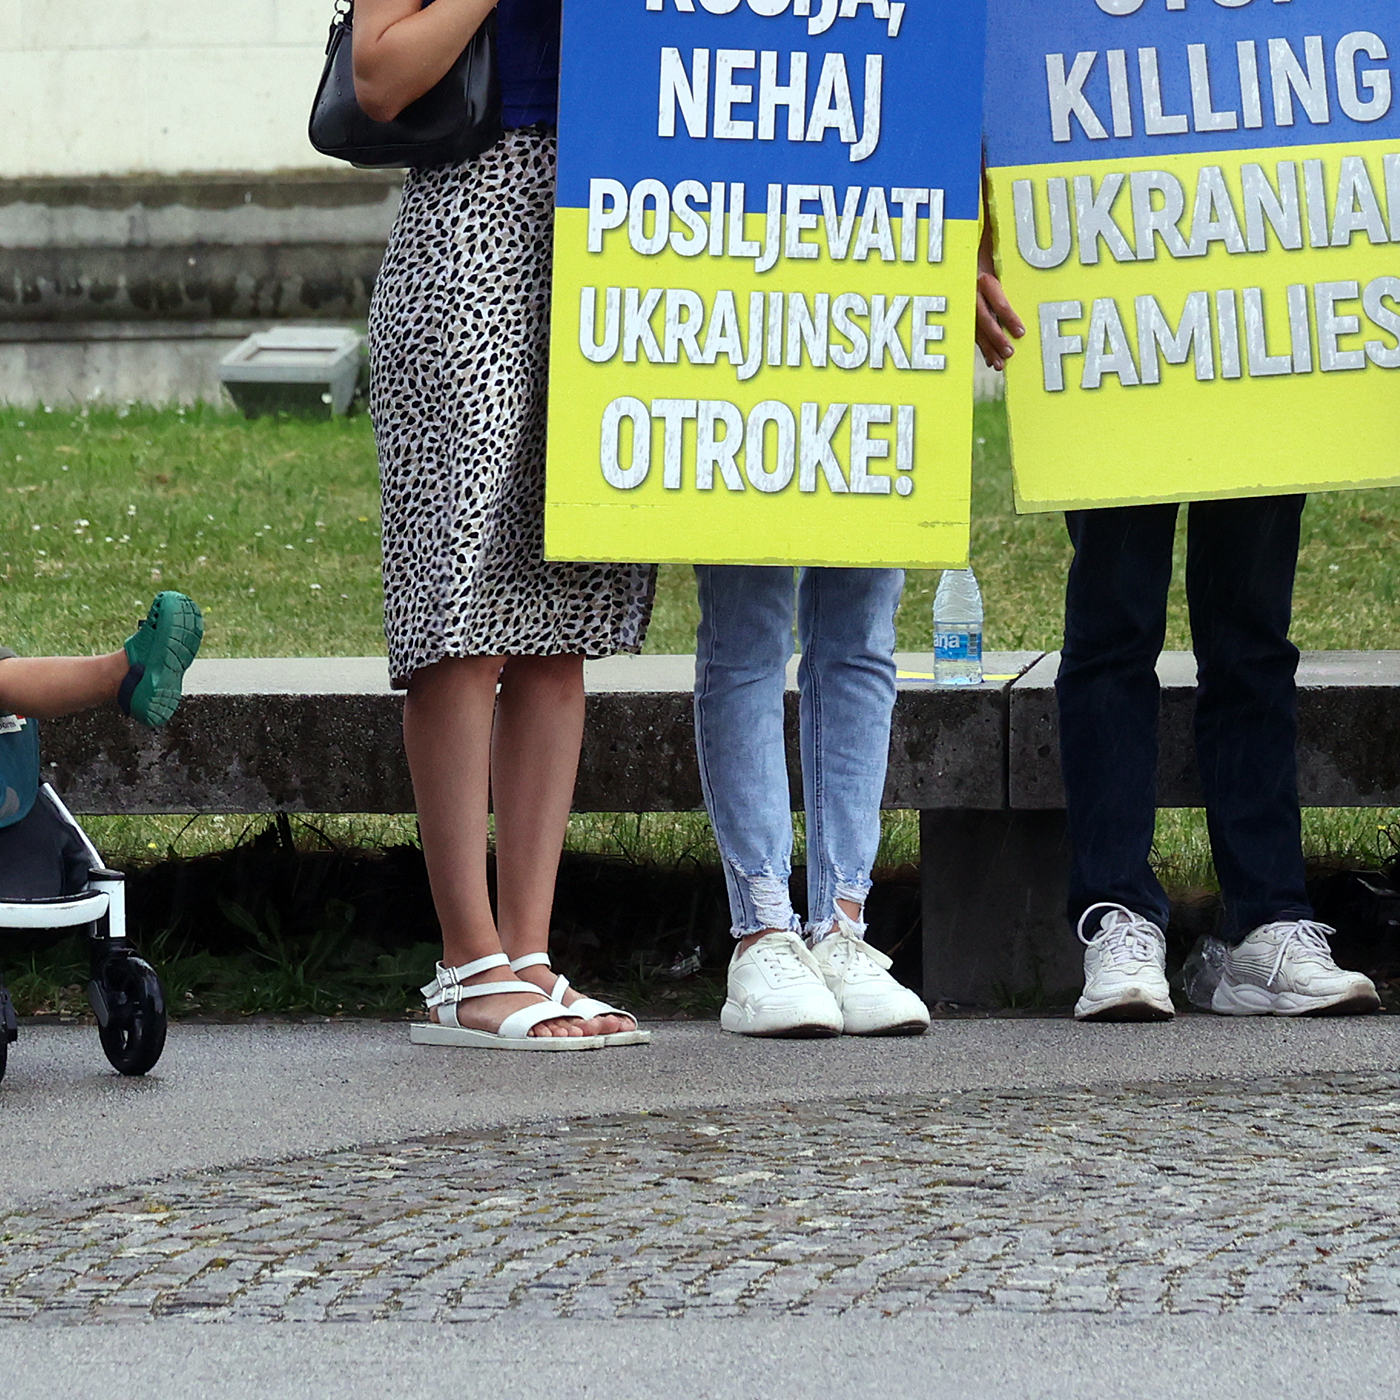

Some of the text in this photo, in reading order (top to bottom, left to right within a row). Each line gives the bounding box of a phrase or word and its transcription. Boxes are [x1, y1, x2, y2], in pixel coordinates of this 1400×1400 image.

[657, 46, 883, 162] NEHAJ
[1045, 30, 1392, 142] KILLING
[587, 177, 945, 273] POSILJEVATI
[578, 286, 947, 381] UKRAJINSKE
[600, 395, 915, 497] OTROKE!
